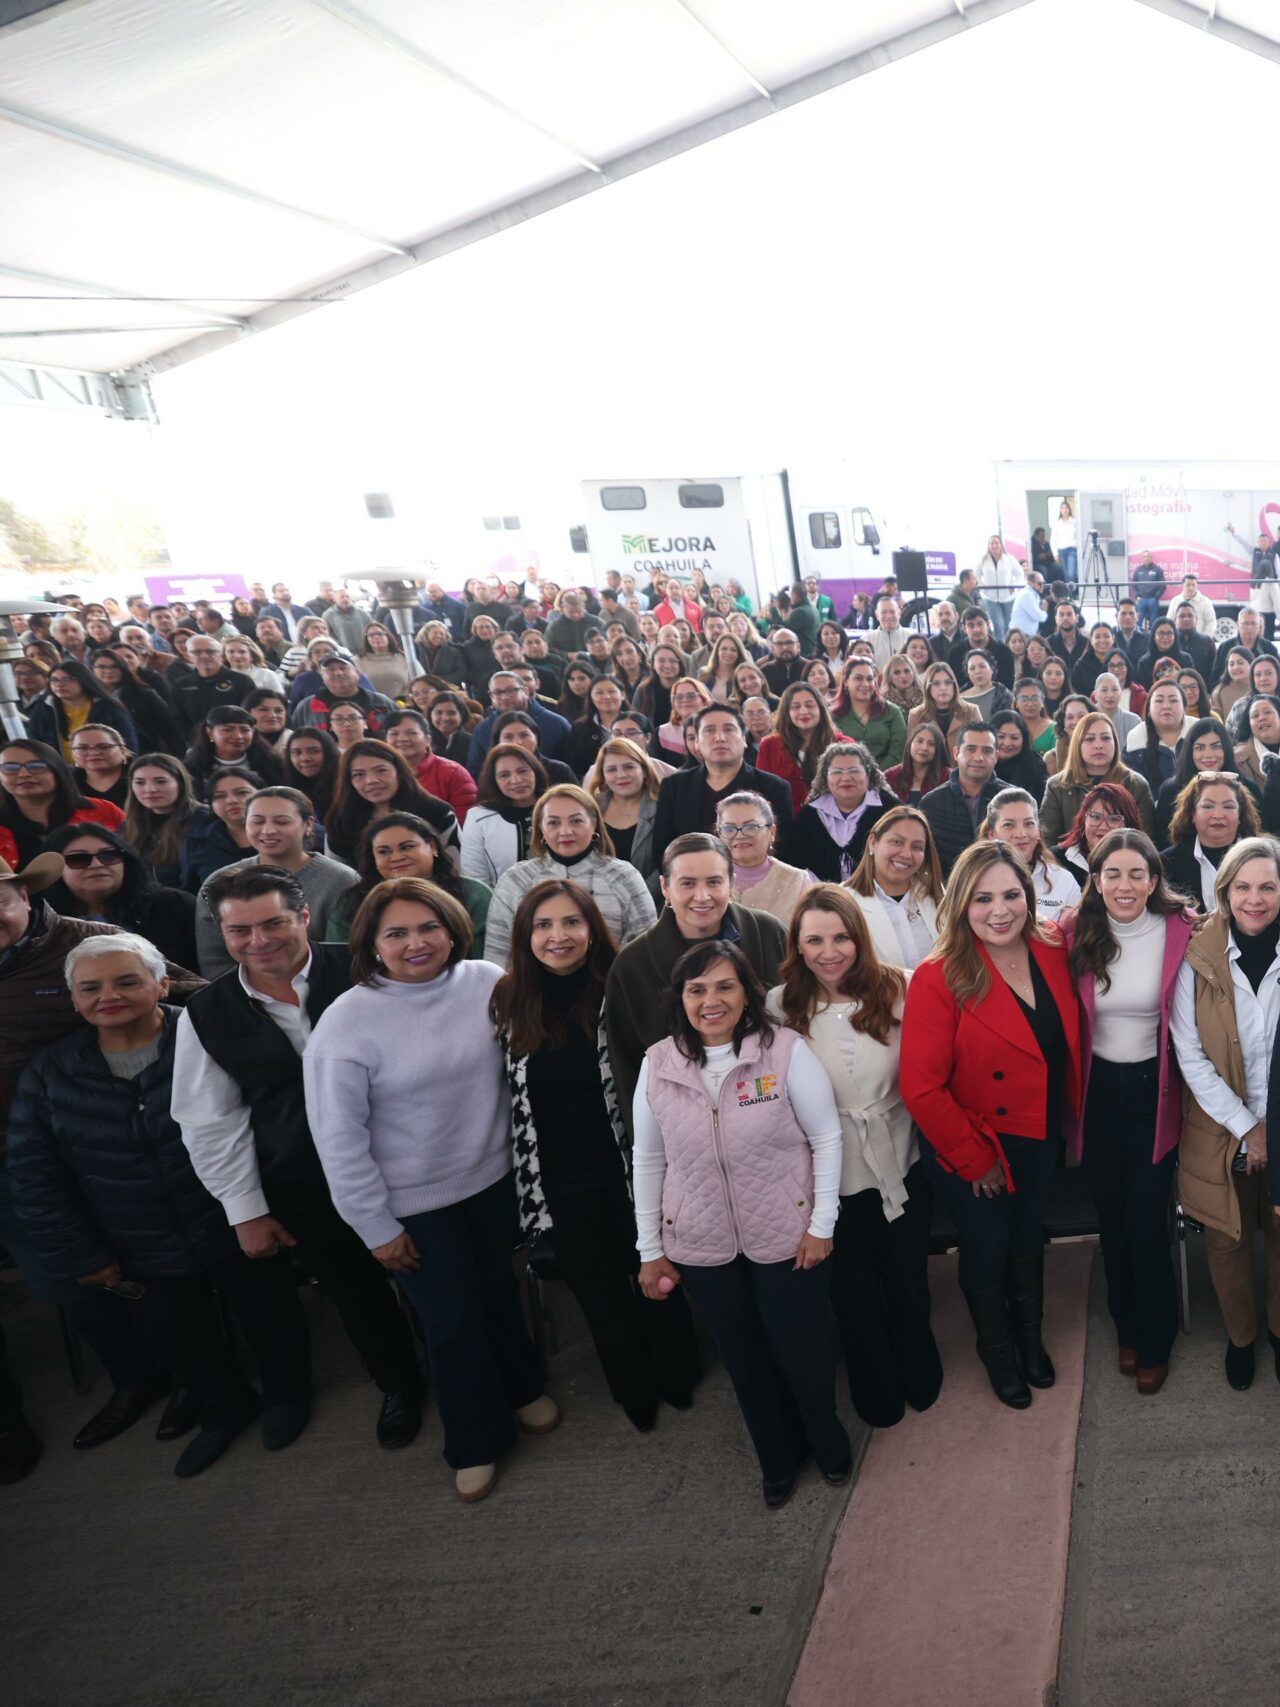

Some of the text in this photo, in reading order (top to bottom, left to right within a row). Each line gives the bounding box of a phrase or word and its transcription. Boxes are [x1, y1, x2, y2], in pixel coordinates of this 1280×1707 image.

[621, 534, 716, 554] MEJORA
[633, 557, 713, 573] COAHUILA
[736, 1074, 777, 1101] DIF
[739, 1094, 779, 1107] COAHUILA
